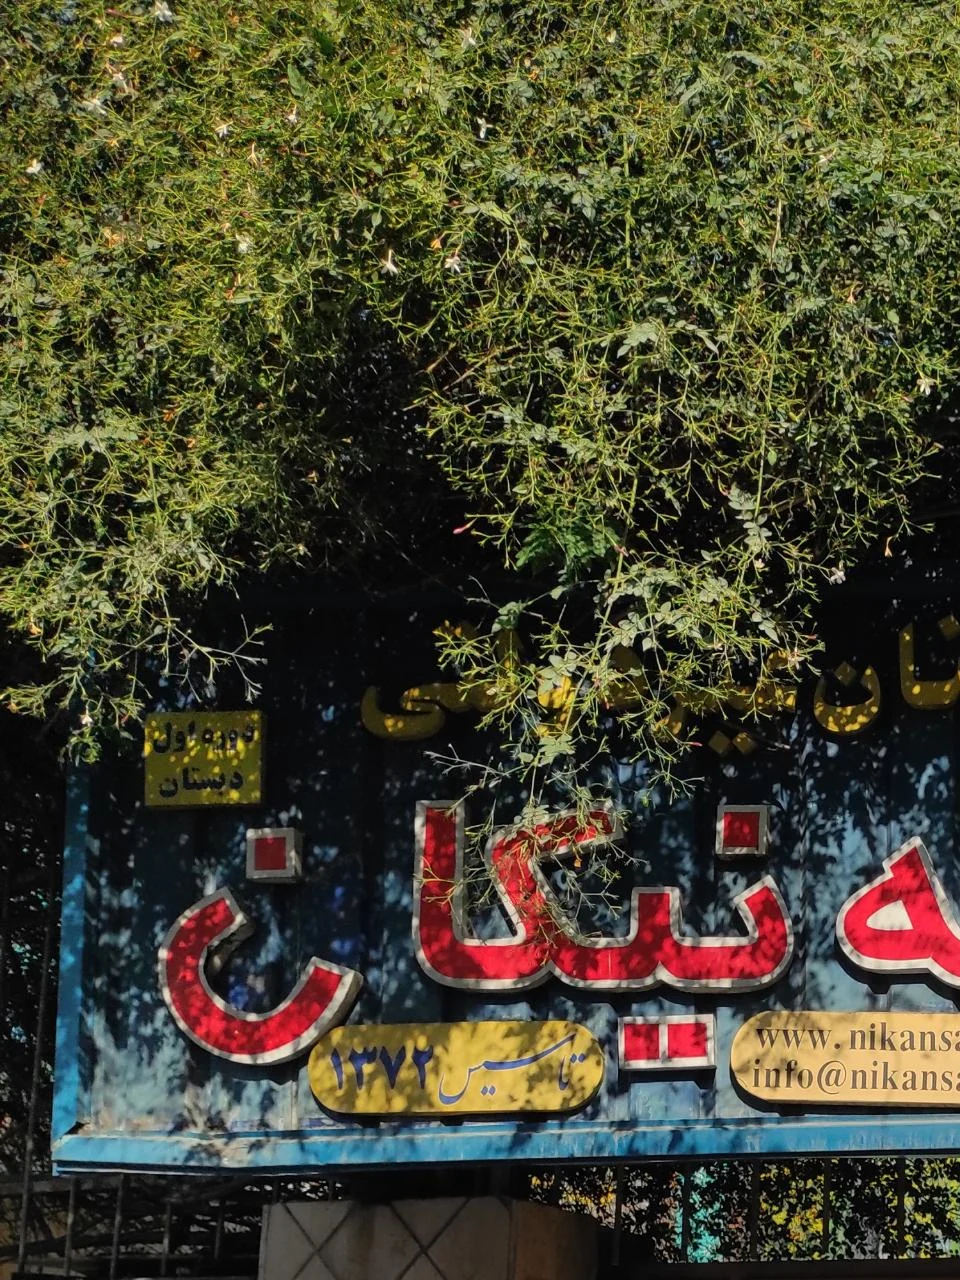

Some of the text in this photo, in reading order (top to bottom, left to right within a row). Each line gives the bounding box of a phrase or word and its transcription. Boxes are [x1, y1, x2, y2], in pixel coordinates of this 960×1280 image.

[158, 766, 244, 798] دبستان
[158, 799, 795, 1071] نیکان
[330, 1045, 434, 1091] ۱۳۷۲
